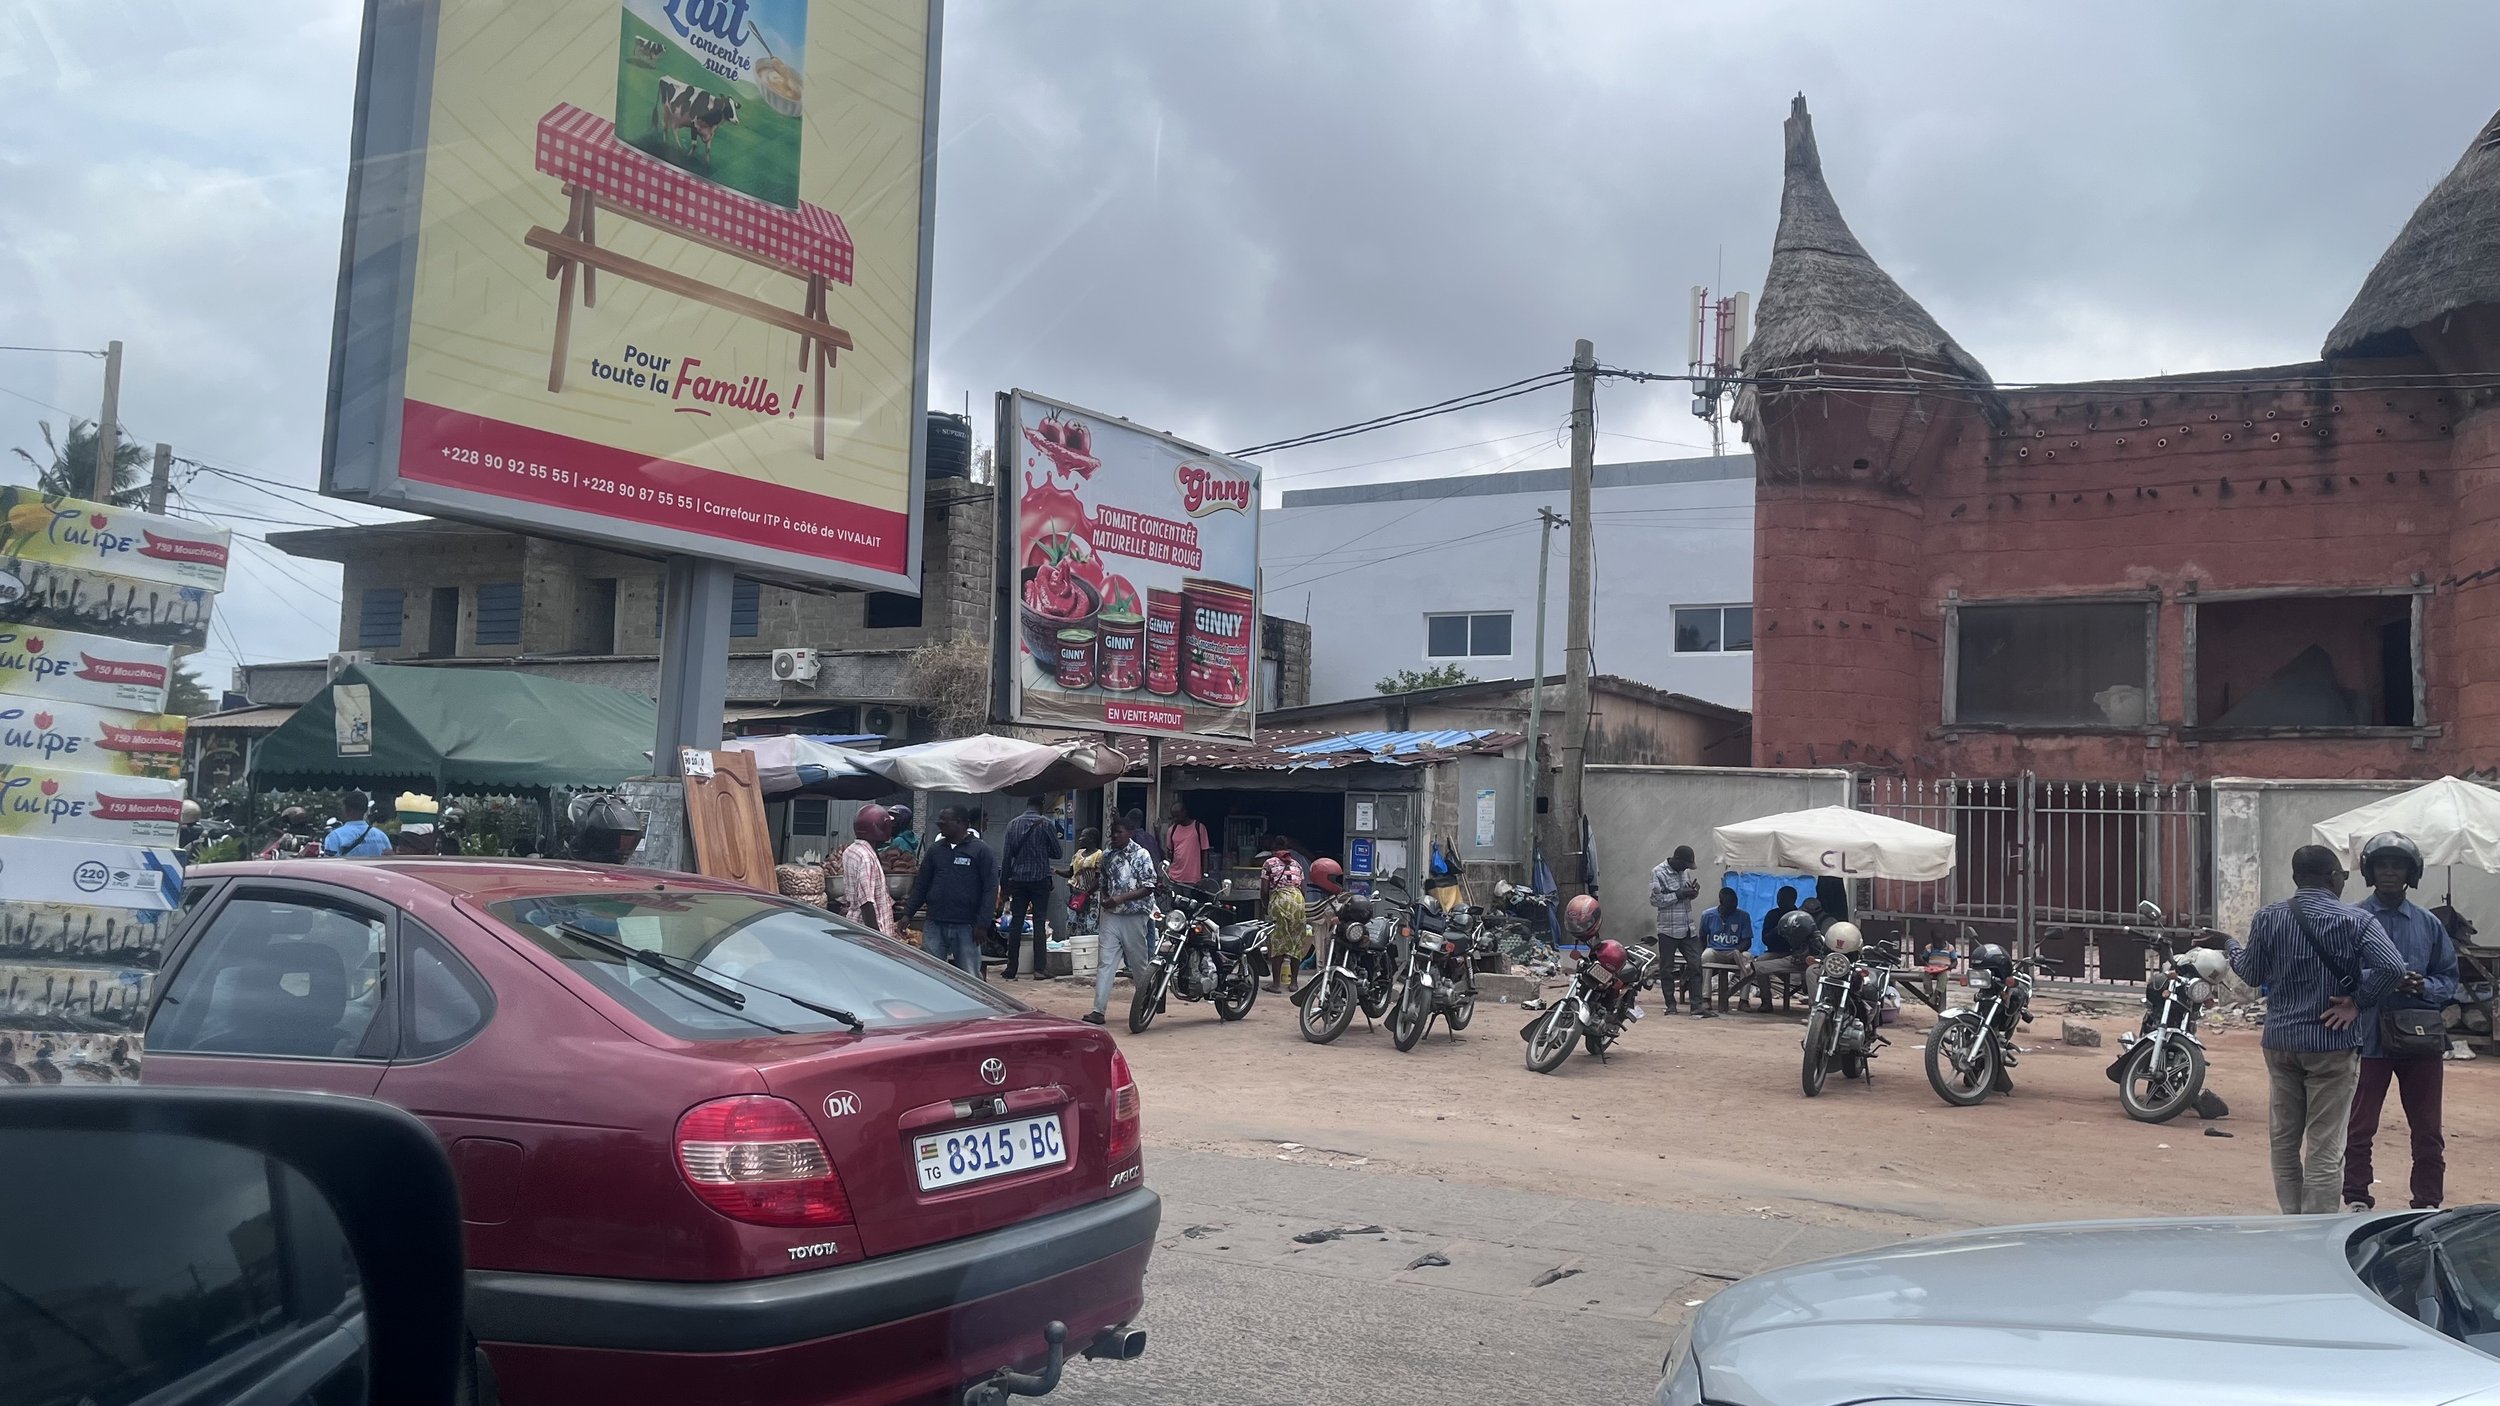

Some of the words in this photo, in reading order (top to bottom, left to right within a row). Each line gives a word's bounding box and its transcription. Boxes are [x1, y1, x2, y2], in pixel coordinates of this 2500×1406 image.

[690, 33, 751, 71] concentré
[703, 58, 739, 82] sucré
[624, 345, 671, 372] Pour
[591, 358, 645, 388] toute
[650, 373, 668, 394] la
[672, 357, 780, 416] Famille
[789, 384, 803, 419] !
[442, 447, 479, 465] +228
[485, 454, 503, 469] 90
[508, 459, 525, 475] 92
[529, 463, 547, 479] 55
[552, 468, 569, 483] 55
[582, 477, 614, 494] +228
[619, 483, 635, 498] 90
[639, 487, 654, 501] 87
[658, 491, 674, 506] 55
[677, 495, 692, 509] 55
[704, 501, 760, 523] Carrefour
[763, 513, 780, 527] ITP
[783, 517, 790, 530] à
[793, 521, 817, 535] côté
[820, 525, 834, 538] de
[837, 529, 881, 548] VIVALAIT
[1179, 466, 1250, 512] Ginny
[1099, 508, 1137, 532] TOMATE
[1139, 518, 1196, 546] CONCENTRÉE
[174, 544, 224, 561] Mouchoirs
[1092, 529, 1146, 556] NATURELLE
[1149, 541, 1169, 560] BIEN
[1171, 547, 1200, 567] ROUGE
[1149, 617, 1175, 634] GINNY
[1195, 607, 1243, 638] GINNY
[1061, 648, 1085, 660] GINNY
[1105, 635, 1134, 650] GINNY
[94, 664, 110, 675] 150
[112, 666, 162, 681] Mouchoirs
[1108, 708, 1120, 720] EN
[1122, 709, 1147, 722] VENTE
[1149, 711, 1181, 725] PARTOUT
[114, 734, 130, 743] 150
[132, 735, 183, 748] Mouchoirs
[110, 803, 126, 813] 150
[128, 804, 179, 816] Mouchoirs
[80, 868, 105, 879] 220
[828, 1095, 857, 1118] DK
[946, 1128, 1014, 1175] 8315
[1029, 1120, 1059, 1160] BC
[925, 1166, 942, 1181] TG
[788, 1242, 838, 1260] TOYOTA
